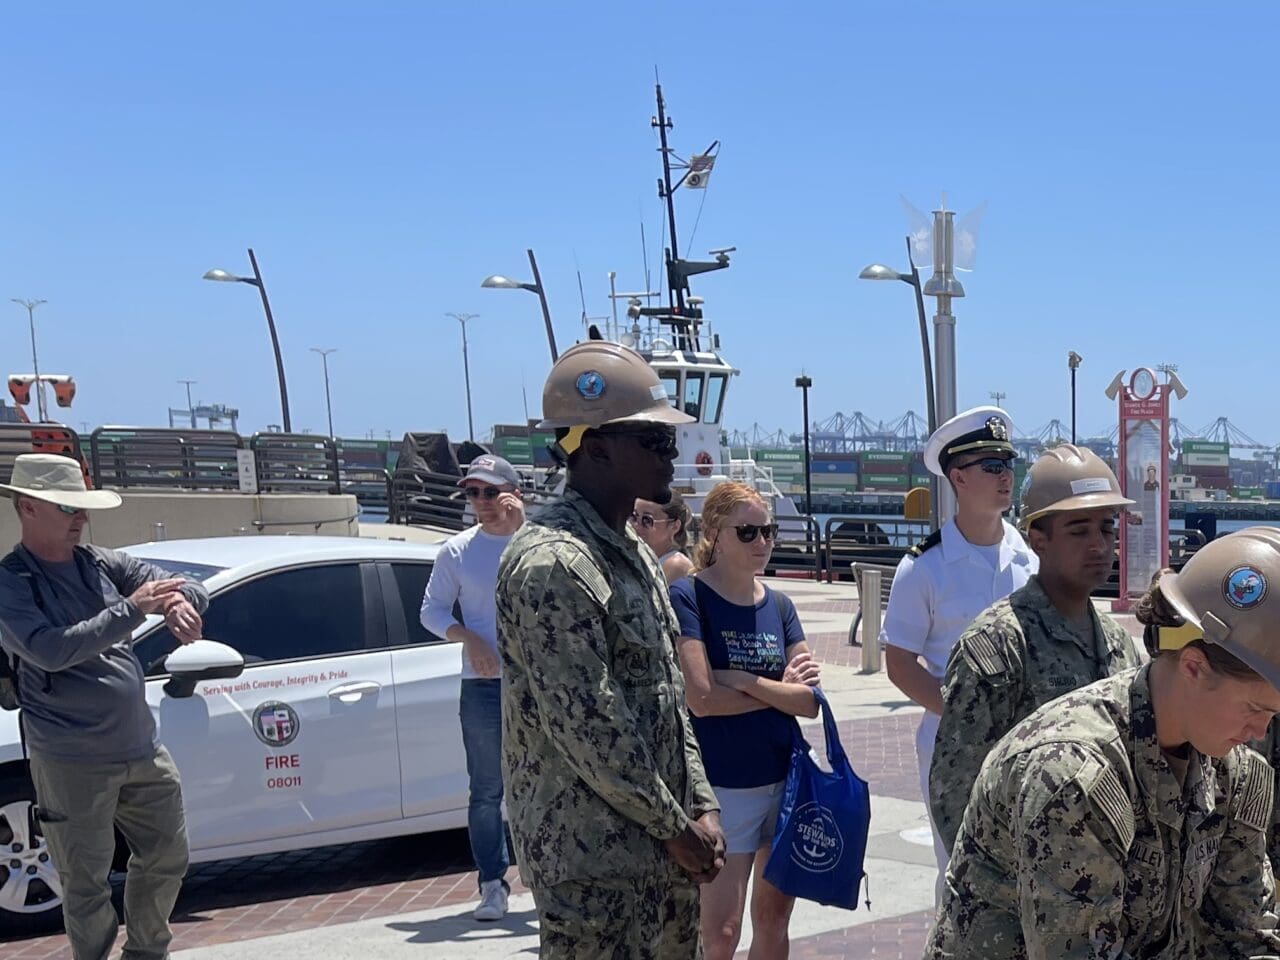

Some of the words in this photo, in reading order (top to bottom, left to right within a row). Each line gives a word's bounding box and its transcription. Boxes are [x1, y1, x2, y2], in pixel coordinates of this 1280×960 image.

[203, 685, 233, 696] Serving
[234, 682, 251, 692] with
[252, 678, 286, 690] Courage,
[287, 674, 319, 686] Integrity
[319, 672, 327, 680] &
[329, 670, 348, 680] Pride
[265, 754, 300, 770] FIRE
[267, 776, 302, 789] 08011
[797, 823, 836, 847] STEWADS
